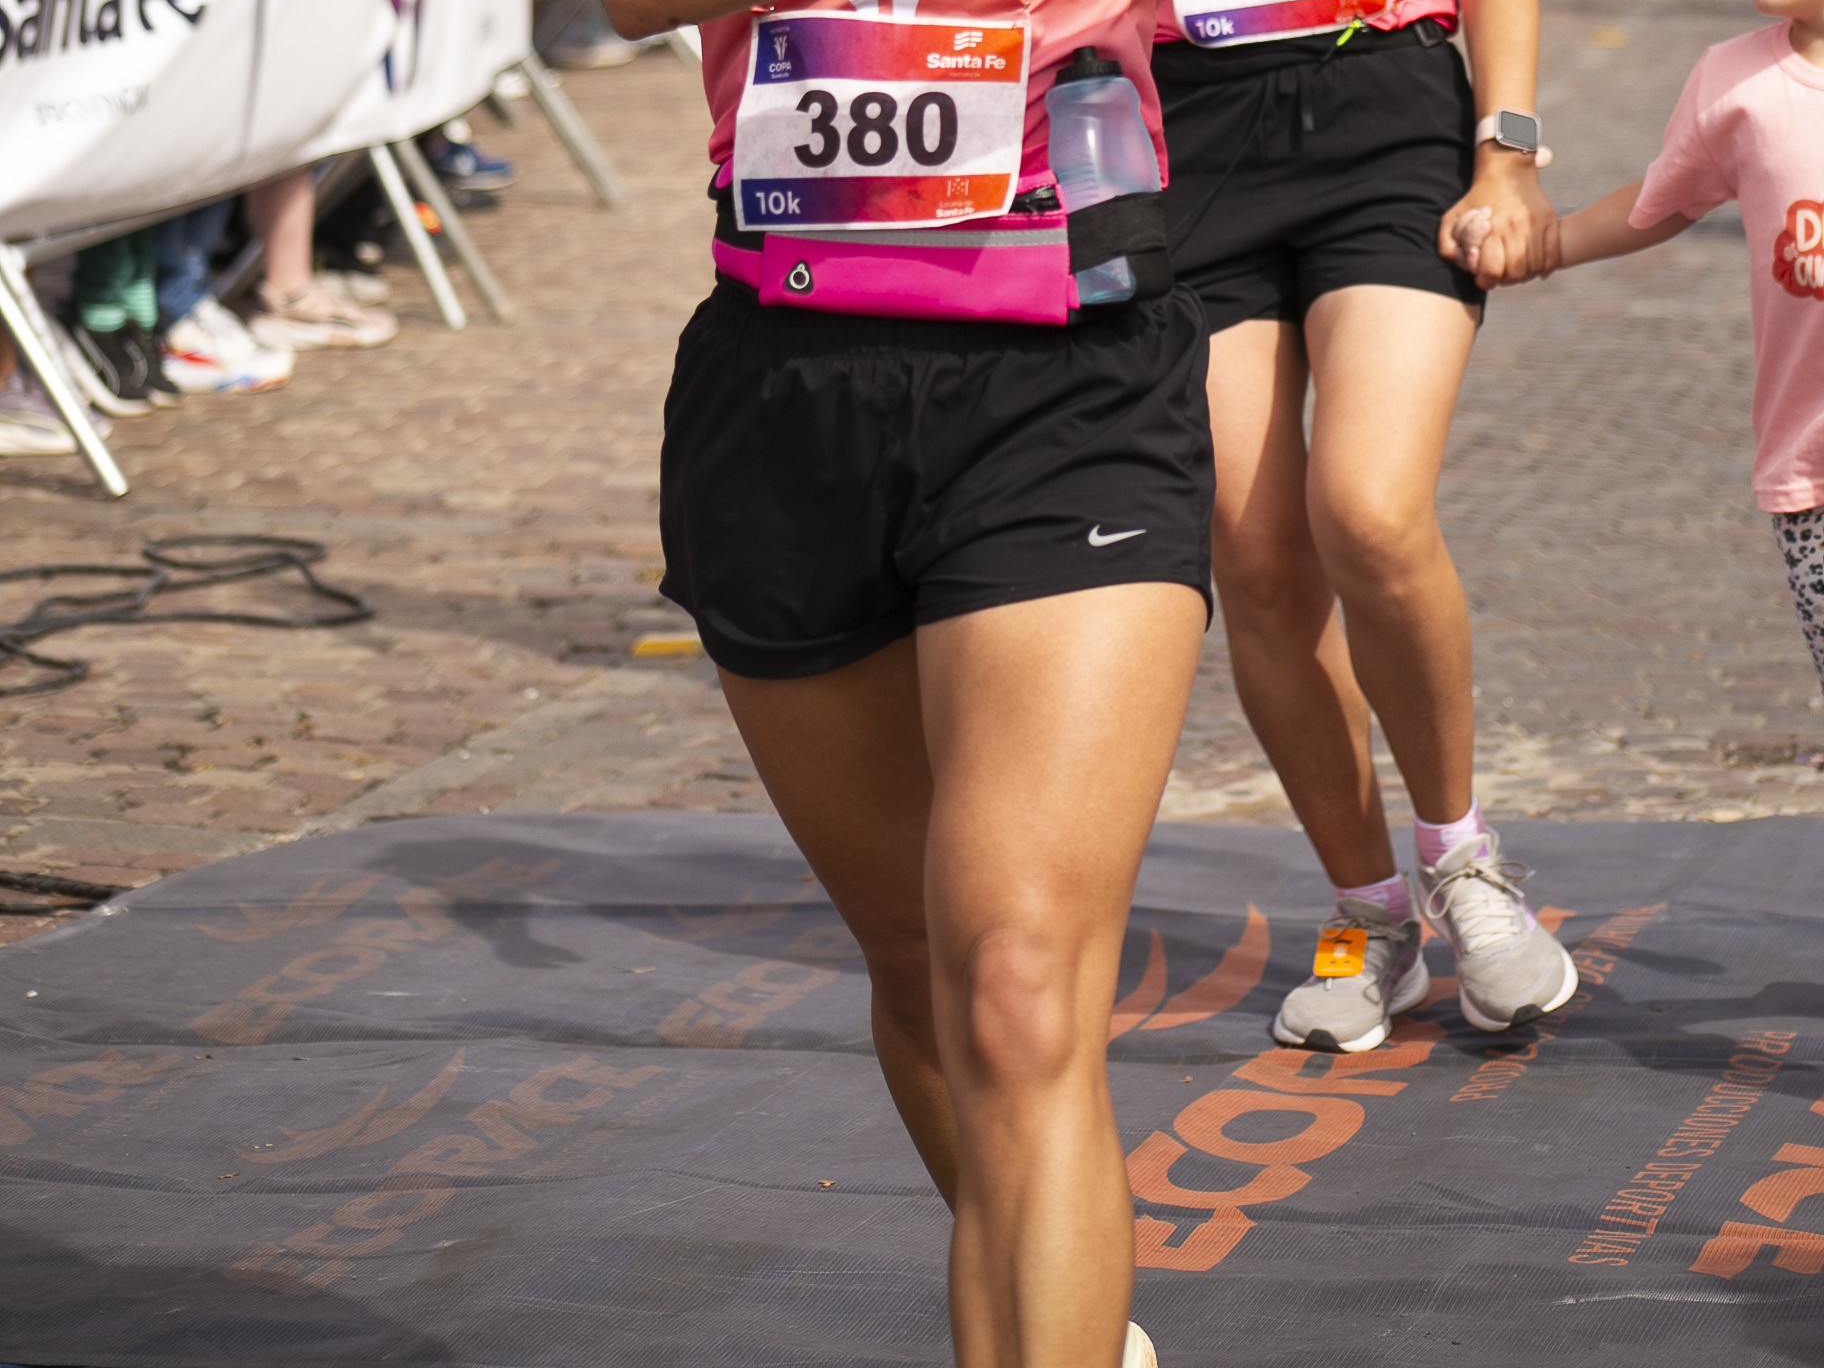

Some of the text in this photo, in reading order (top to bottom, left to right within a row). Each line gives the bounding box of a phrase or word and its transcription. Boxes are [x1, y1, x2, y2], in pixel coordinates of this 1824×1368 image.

[1194, 16, 1235, 38] 10k
[768, 62, 792, 73] COPA
[926, 53, 1007, 70] Santa Fe
[794, 89, 958, 168] 380
[755, 190, 801, 215] 10k
[1657, 1029, 1798, 1158] PRODUCCIONES
[1567, 1162, 1703, 1268] DEPORTIVAS
